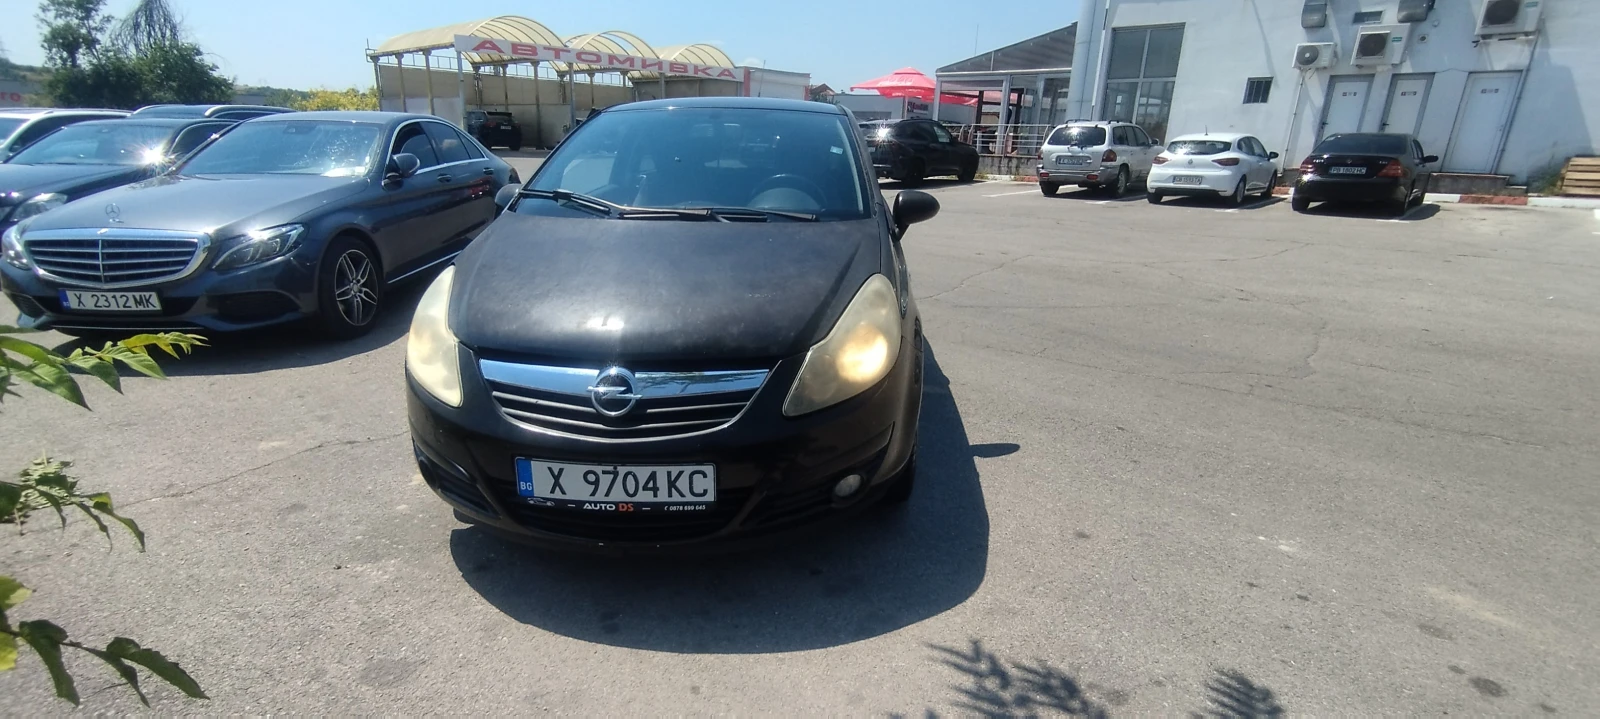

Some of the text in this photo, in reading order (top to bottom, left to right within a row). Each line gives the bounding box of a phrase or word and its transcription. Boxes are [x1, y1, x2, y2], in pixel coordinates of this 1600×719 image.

[472, 40, 736, 79] АВТОМИВКА
[74, 293, 86, 307] X
[520, 482, 533, 491] BG
[547, 467, 567, 495] X
[583, 502, 634, 512] AUTO DS
